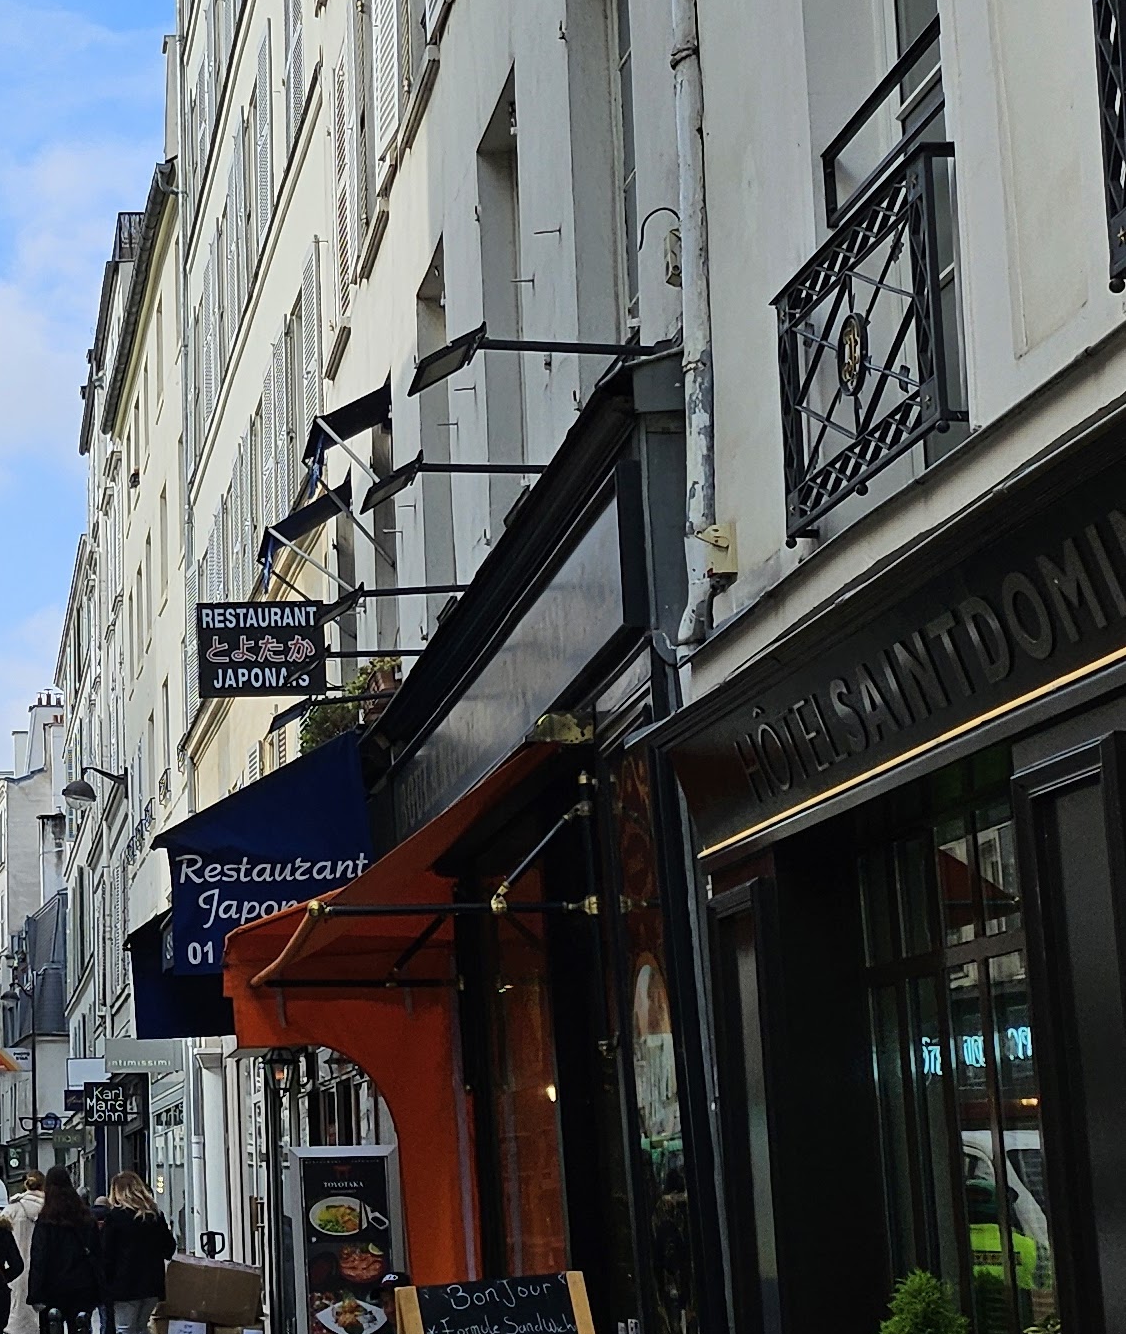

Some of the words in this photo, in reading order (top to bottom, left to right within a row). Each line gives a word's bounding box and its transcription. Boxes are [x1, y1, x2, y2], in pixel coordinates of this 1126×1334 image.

[958, 509, 1126, 684] DOMI
[201, 607, 317, 628] RESTAURANT
[206, 635, 315, 662] とよたか
[175, 852, 369, 884] Restaurant
[187, 941, 214, 965] 01
[107, 1059, 171, 1067] intimissimi
[94, 1086, 124, 1100] Karl
[86, 1097, 124, 1111] Marc
[87, 1109, 124, 1122] John
